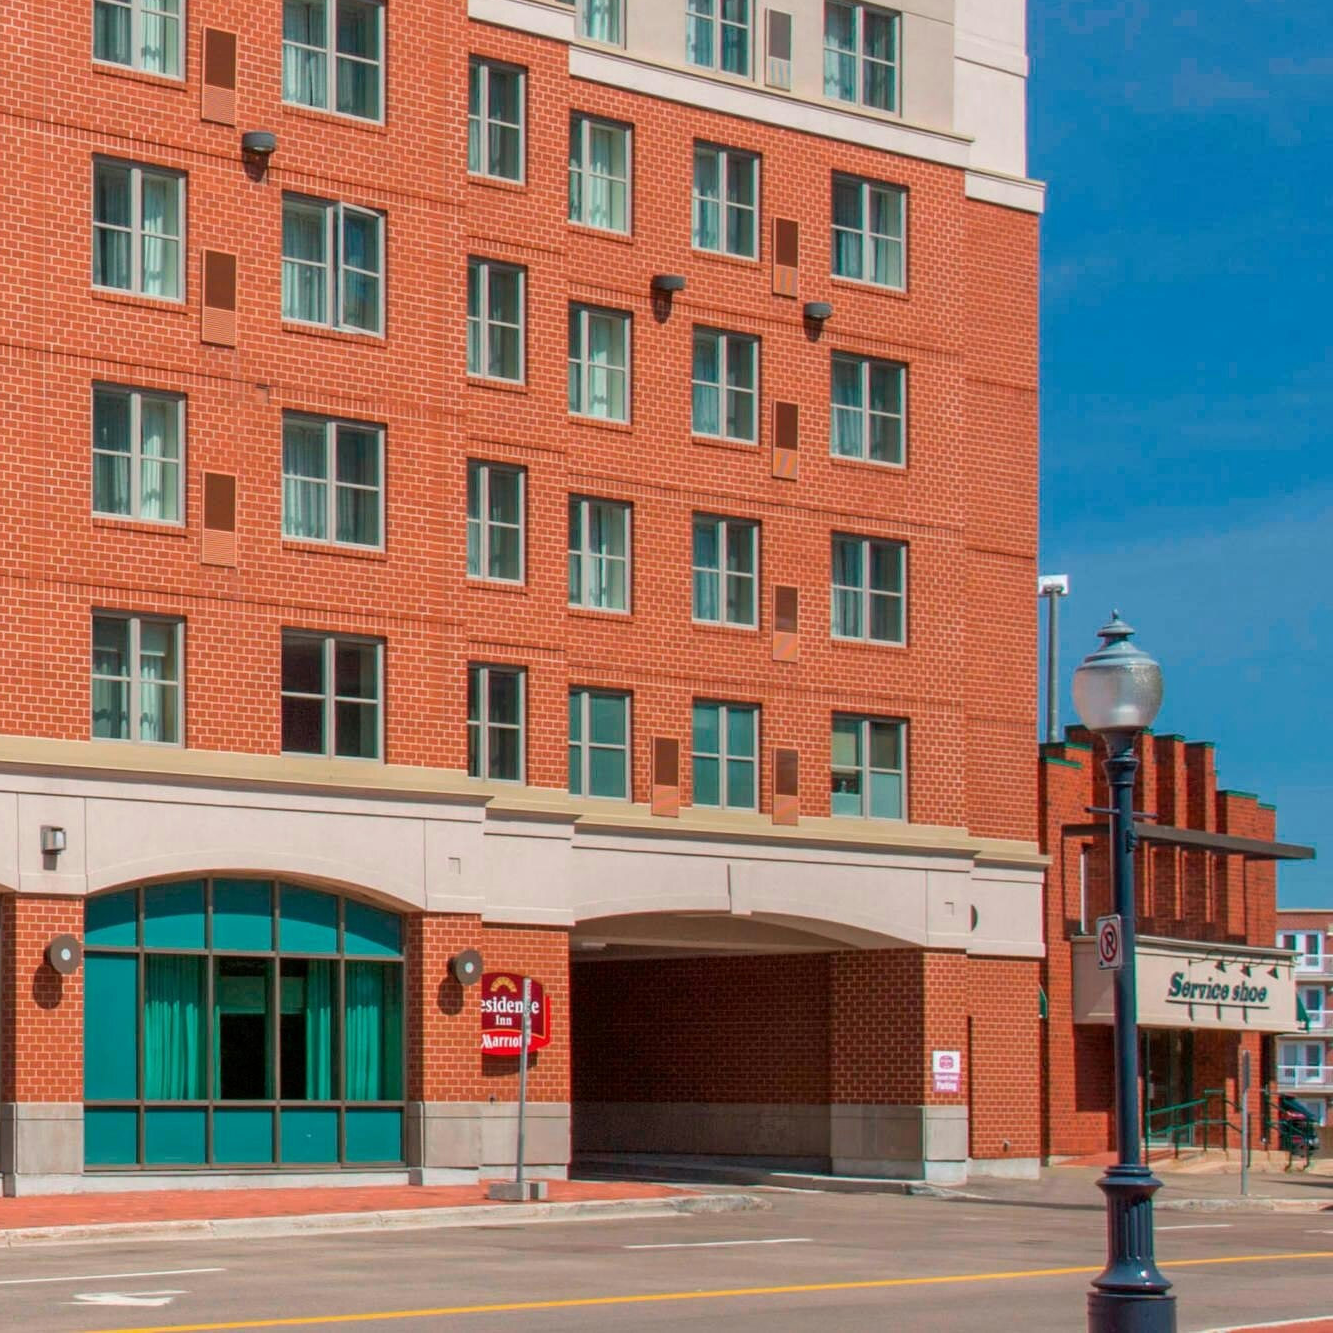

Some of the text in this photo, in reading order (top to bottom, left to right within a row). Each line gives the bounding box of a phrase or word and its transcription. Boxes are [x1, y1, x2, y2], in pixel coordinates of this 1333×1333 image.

[1168, 971, 1268, 1002] Service shoe
[495, 1014, 513, 1026] Inn
